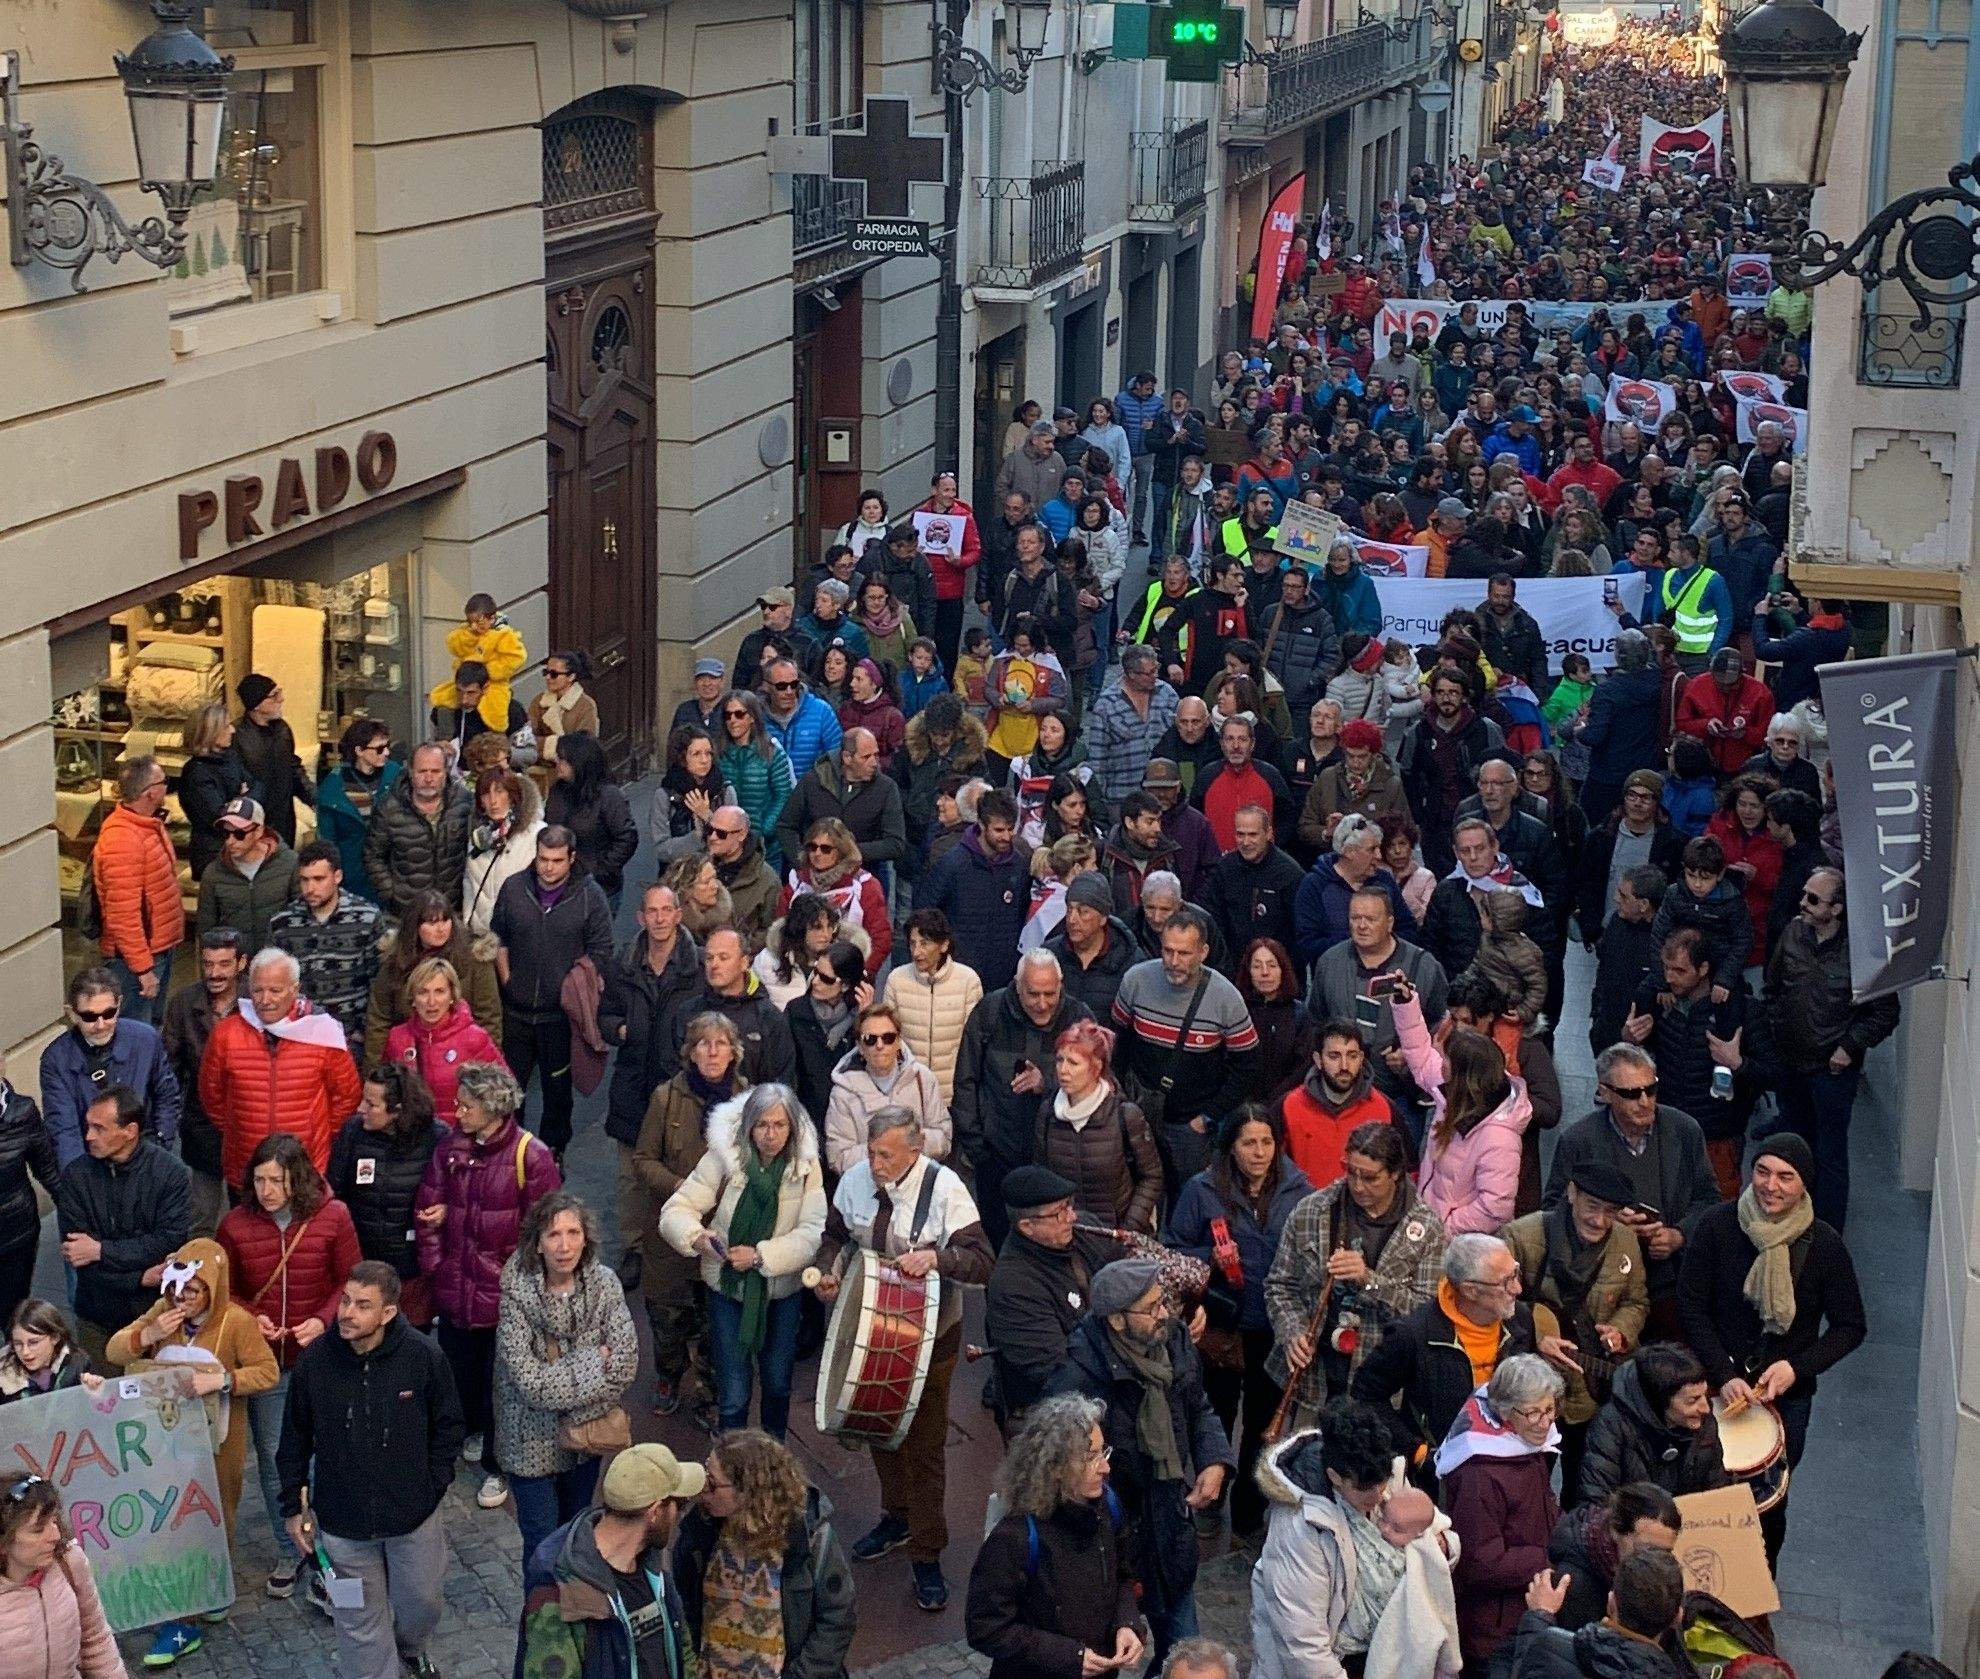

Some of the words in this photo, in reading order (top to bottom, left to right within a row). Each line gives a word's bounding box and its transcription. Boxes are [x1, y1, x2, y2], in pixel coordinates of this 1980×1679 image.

[1173, 22, 1217, 42] 10°C
[857, 223, 920, 236] FARMACIA
[852, 239, 924, 253] ORTOPEDIA
[1383, 309, 1439, 336] NO
[177, 429, 398, 561] PRADO
[1383, 615, 1444, 635] Parqu
[1543, 637, 1617, 654] tacua
[14, 1420, 153, 1486] VAR
[69, 1479, 221, 1551] ROYA
